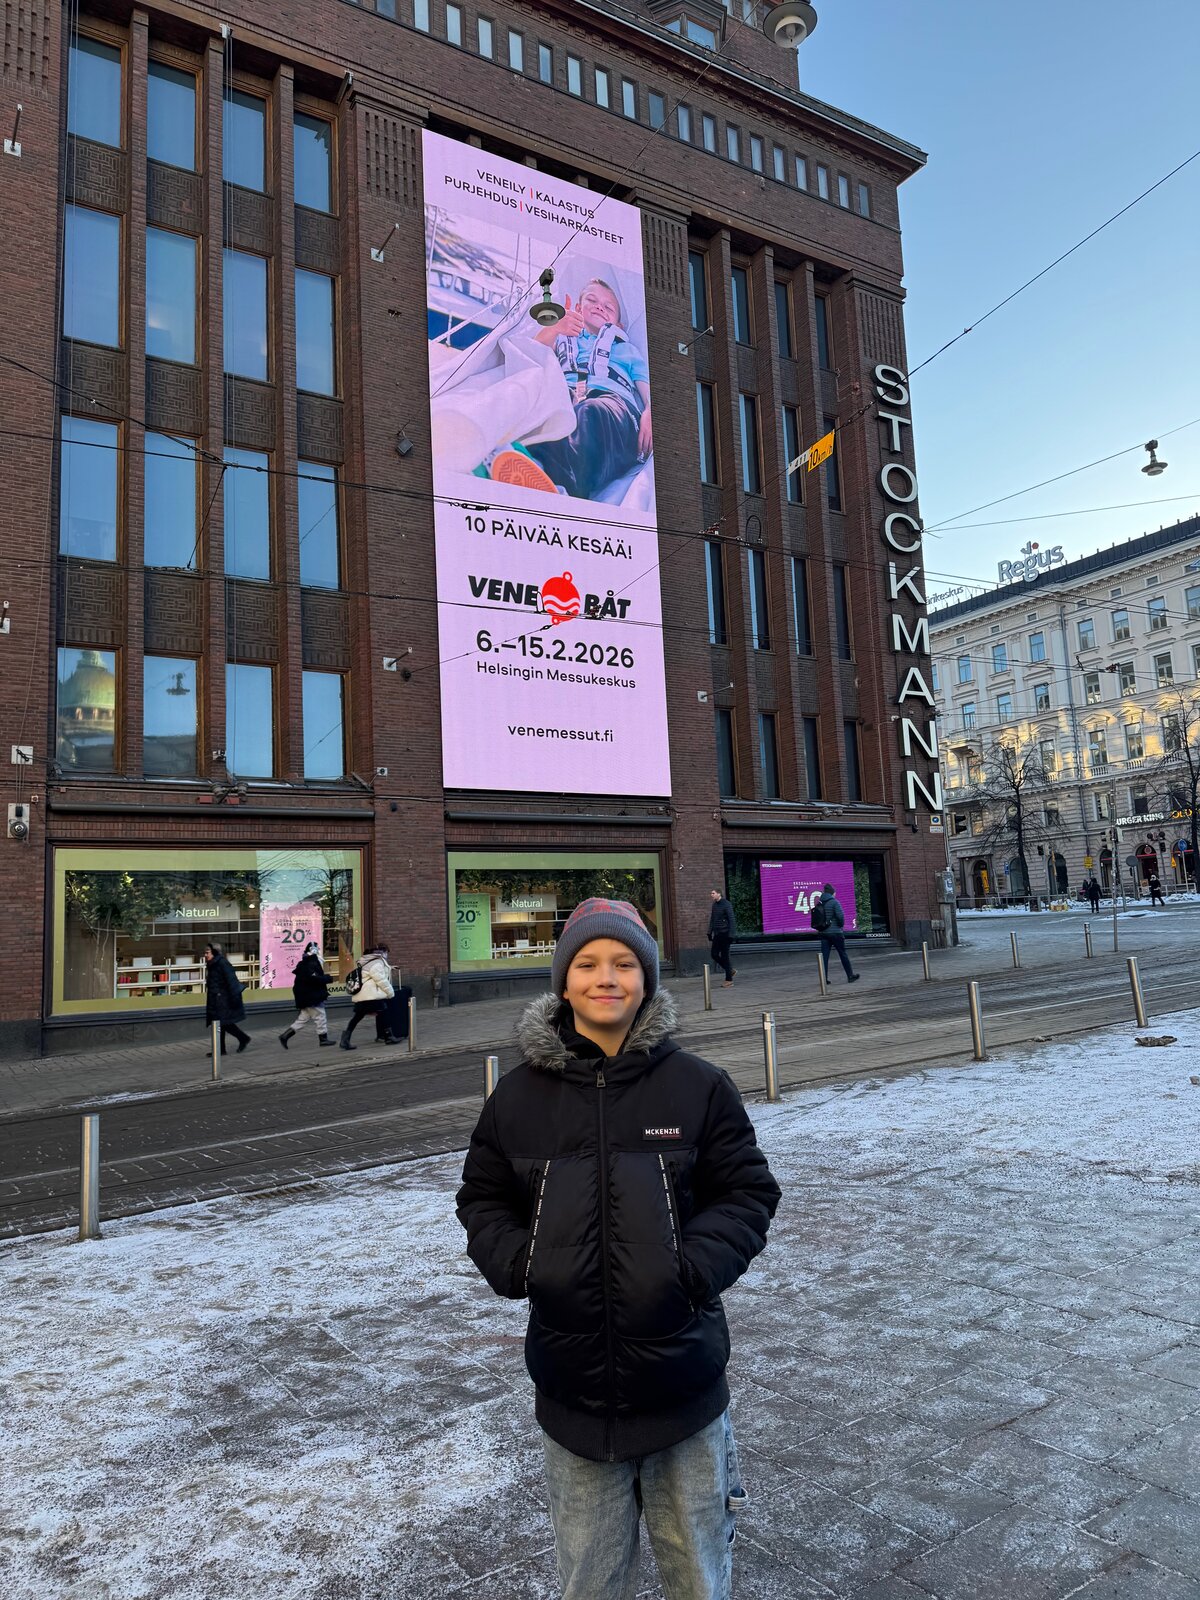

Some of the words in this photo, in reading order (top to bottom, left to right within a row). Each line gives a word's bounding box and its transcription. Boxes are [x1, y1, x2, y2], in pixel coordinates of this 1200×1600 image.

[444, 175, 518, 209] PURJEHDUS
[525, 203, 624, 245] VESIHARRASTEET
[477, 169, 526, 195] VENEILY
[536, 190, 595, 219] KALASTUS
[465, 515, 486, 533] 10
[491, 518, 563, 548] PÄIVÄÄ
[568, 535, 633, 560] KESÄÄ!
[997, 544, 1065, 583] Regus
[468, 575, 539, 607] VENE
[584, 590, 632, 619] BÅT
[872, 363, 943, 812] STOCKMANN
[476, 661, 544, 681] Helsingin
[546, 669, 636, 689] Messukeskus
[507, 725, 614, 742] venemessut.fi
[1113, 815, 1143, 826] URGER
[1143, 812, 1165, 822] KING
[175, 906, 220, 918] Natural
[512, 898, 543, 908] Natural
[645, 1127, 681, 1135] MCKENZIE
